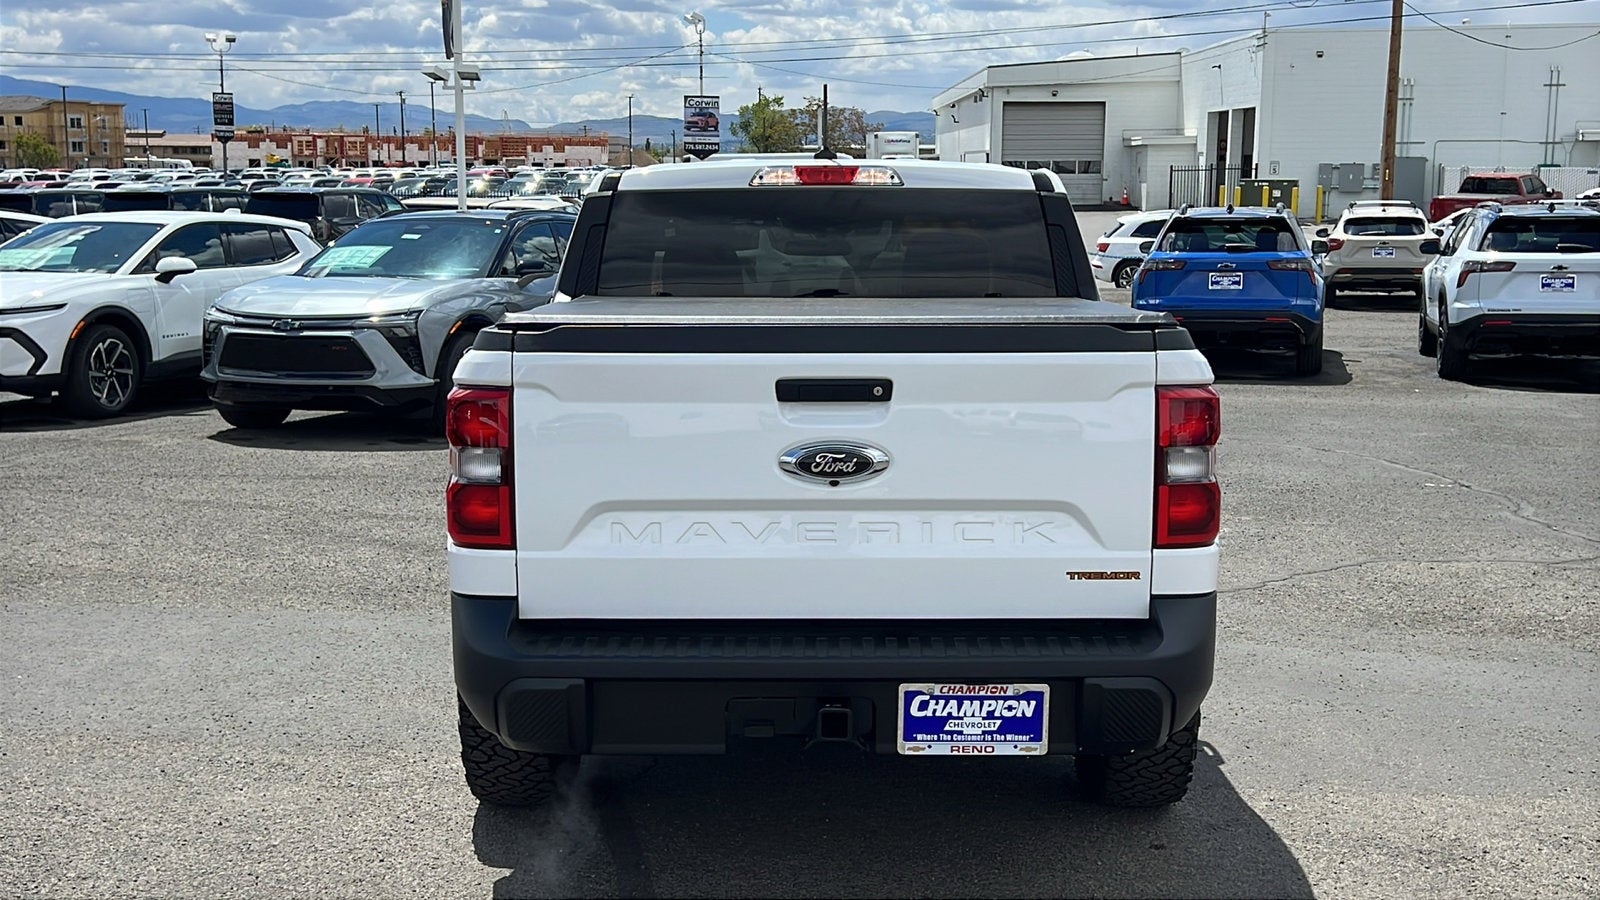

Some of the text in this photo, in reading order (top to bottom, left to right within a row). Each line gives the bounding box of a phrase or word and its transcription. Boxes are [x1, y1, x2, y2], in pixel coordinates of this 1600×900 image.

[687, 98, 719, 107] Corwin
[811, 452, 858, 472] Ford
[610, 521, 1057, 544] MAVERICK
[1066, 571, 1141, 580] TREMOR
[939, 685, 1009, 695] CHAMPION
[909, 694, 1037, 717] CHAMPION
[948, 721, 998, 729] CHEVROLET
[939, 733, 952, 741] The
[953, 733, 984, 741] Customer
[985, 733, 992, 741] Is
[993, 733, 1005, 741] The
[950, 745, 995, 754] RENO
